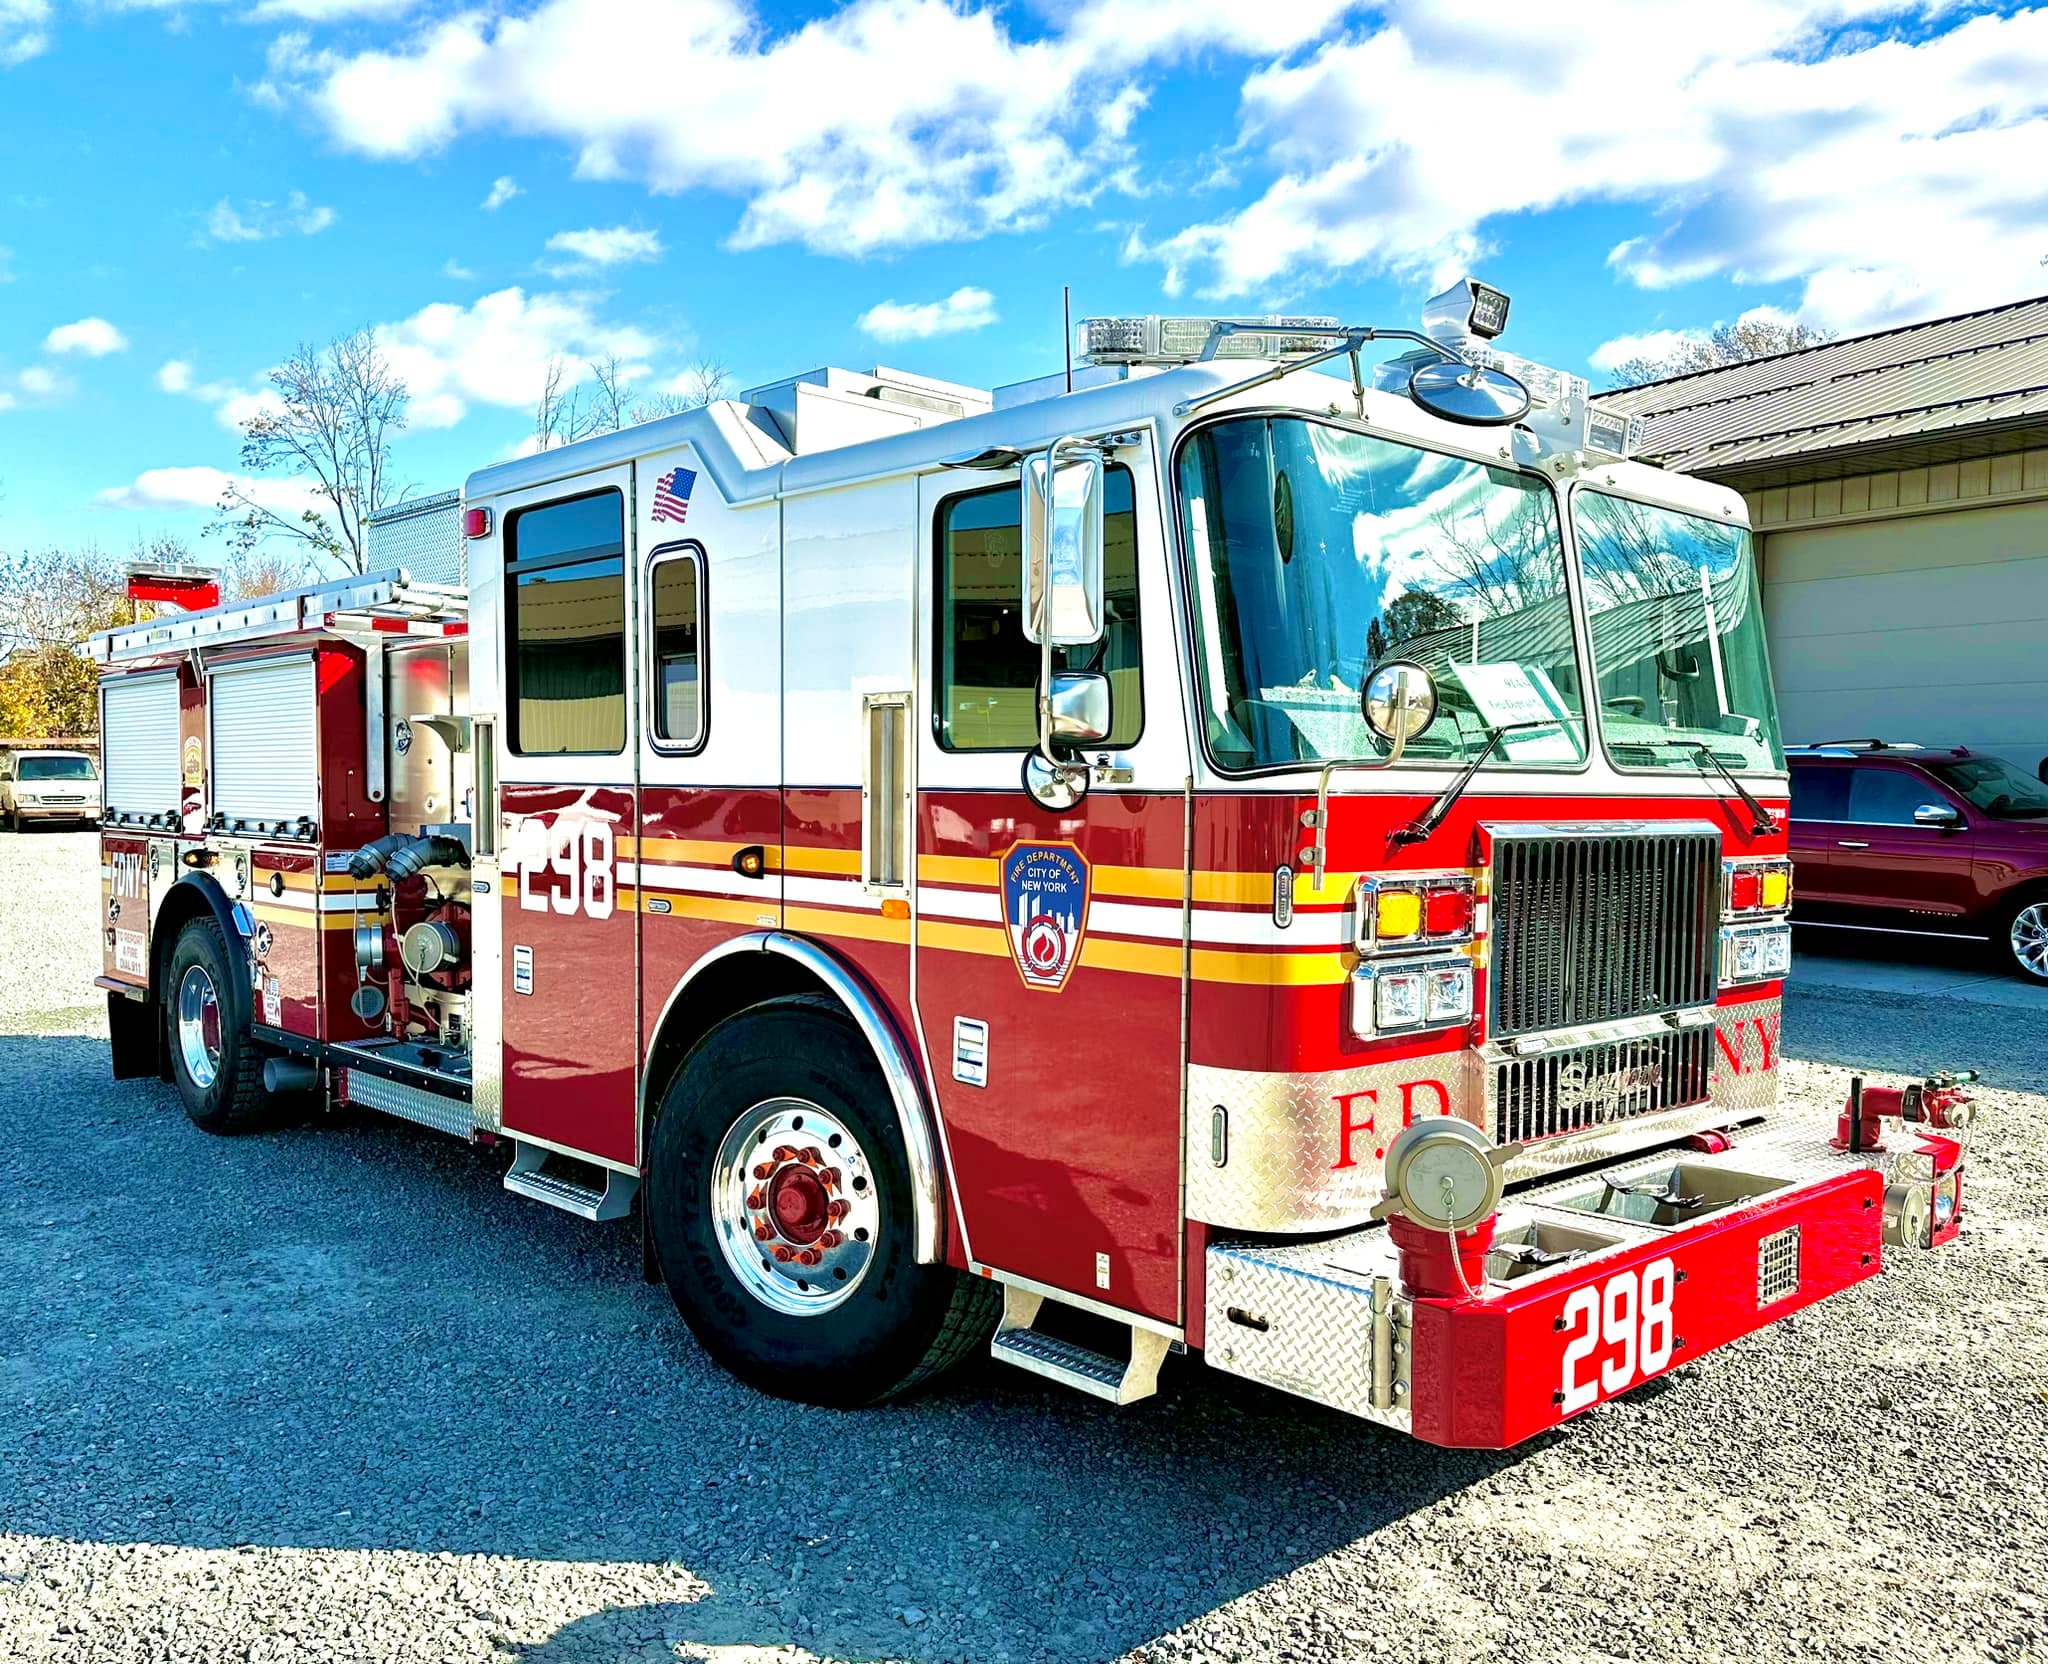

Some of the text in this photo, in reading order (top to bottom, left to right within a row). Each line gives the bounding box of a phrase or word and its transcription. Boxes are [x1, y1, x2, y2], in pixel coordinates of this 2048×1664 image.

[111, 851, 143, 899] FDNY
[520, 816, 614, 920] 298
[1010, 851, 1080, 885] FIRE DEPARTMENT
[1027, 867, 1061, 880] CITY OF
[1021, 879, 1068, 893] NEW YORK
[124, 931, 143, 945] REPORT
[1562, 1256, 1675, 1417] 298
